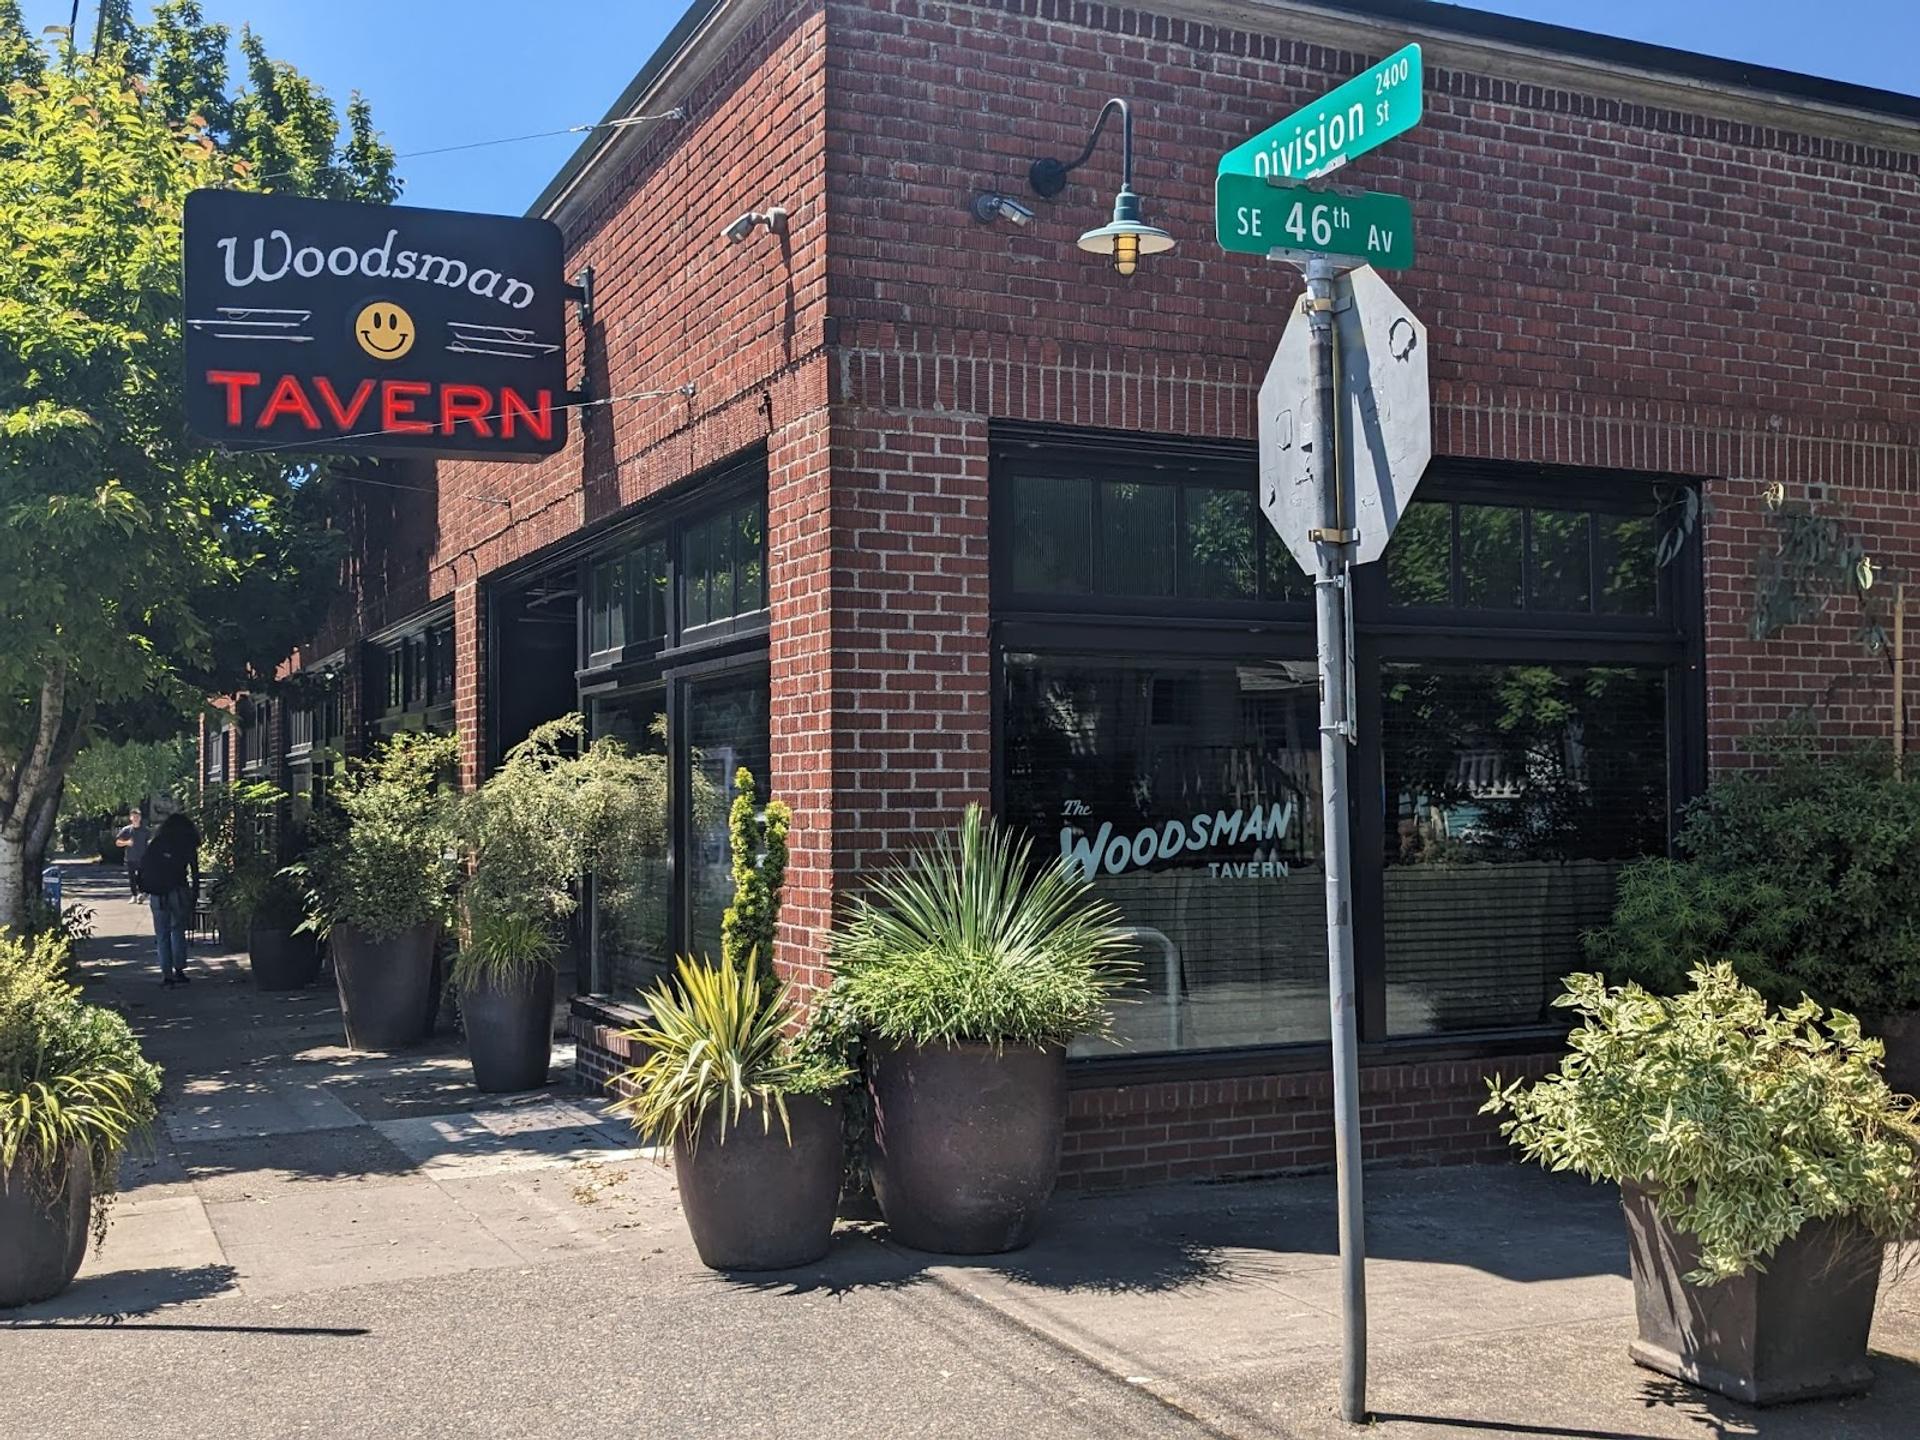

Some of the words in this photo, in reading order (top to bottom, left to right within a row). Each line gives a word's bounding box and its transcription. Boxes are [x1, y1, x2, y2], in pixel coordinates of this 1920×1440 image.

[1375, 58, 1408, 96] 2400
[1376, 100, 1389, 126] St
[1237, 206, 1262, 237] SE
[1285, 202, 1350, 245] 46th
[1367, 224, 1393, 253] Av
[217, 230, 535, 309] Woodsman
[206, 370, 552, 441] TAVERN
[1061, 799, 1092, 816] The
[1059, 802, 1292, 883] WOODSMAN
[1208, 862, 1289, 879] TAVERN
